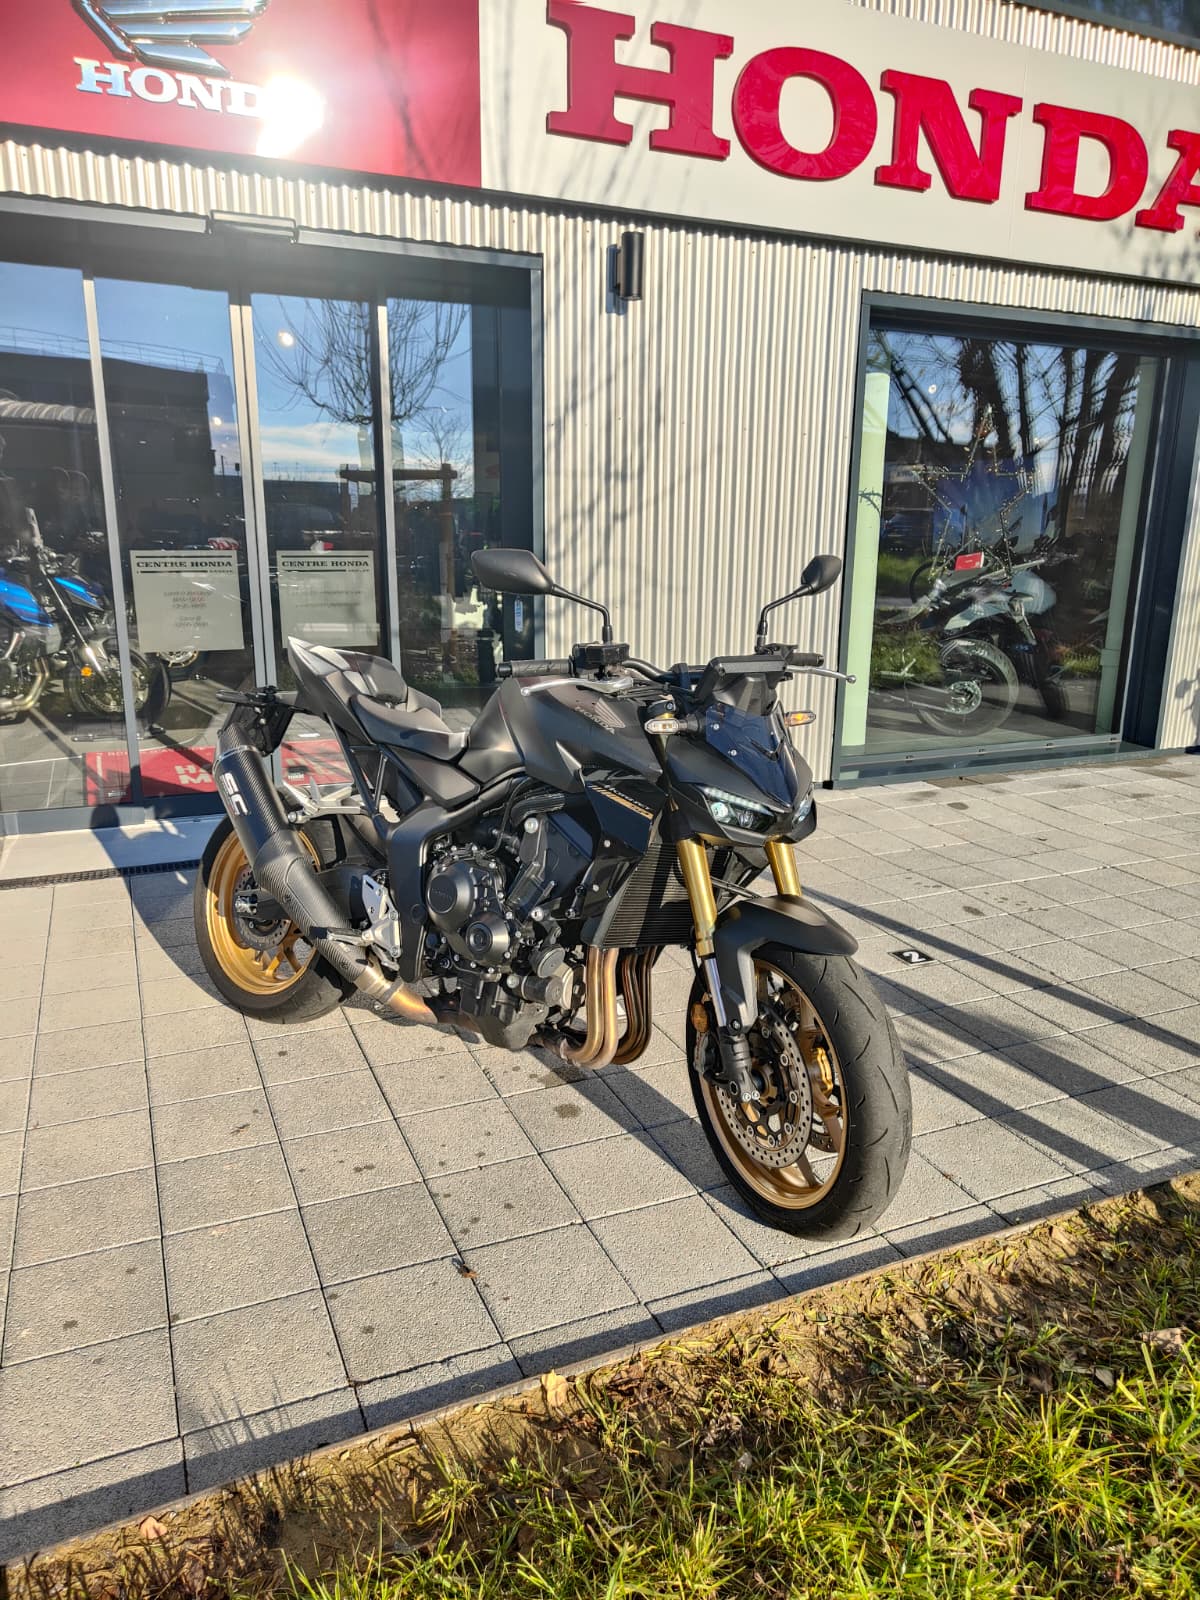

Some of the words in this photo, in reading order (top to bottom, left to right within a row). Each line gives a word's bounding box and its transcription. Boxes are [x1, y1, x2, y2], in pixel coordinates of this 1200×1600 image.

[73, 57, 302, 125] HOND
[136, 560, 187, 568] CENTRE
[190, 560, 233, 568] HONDA
[281, 560, 328, 568] CENTRE
[574, 706, 616, 735] HONDA
[902, 950, 927, 963] 2
